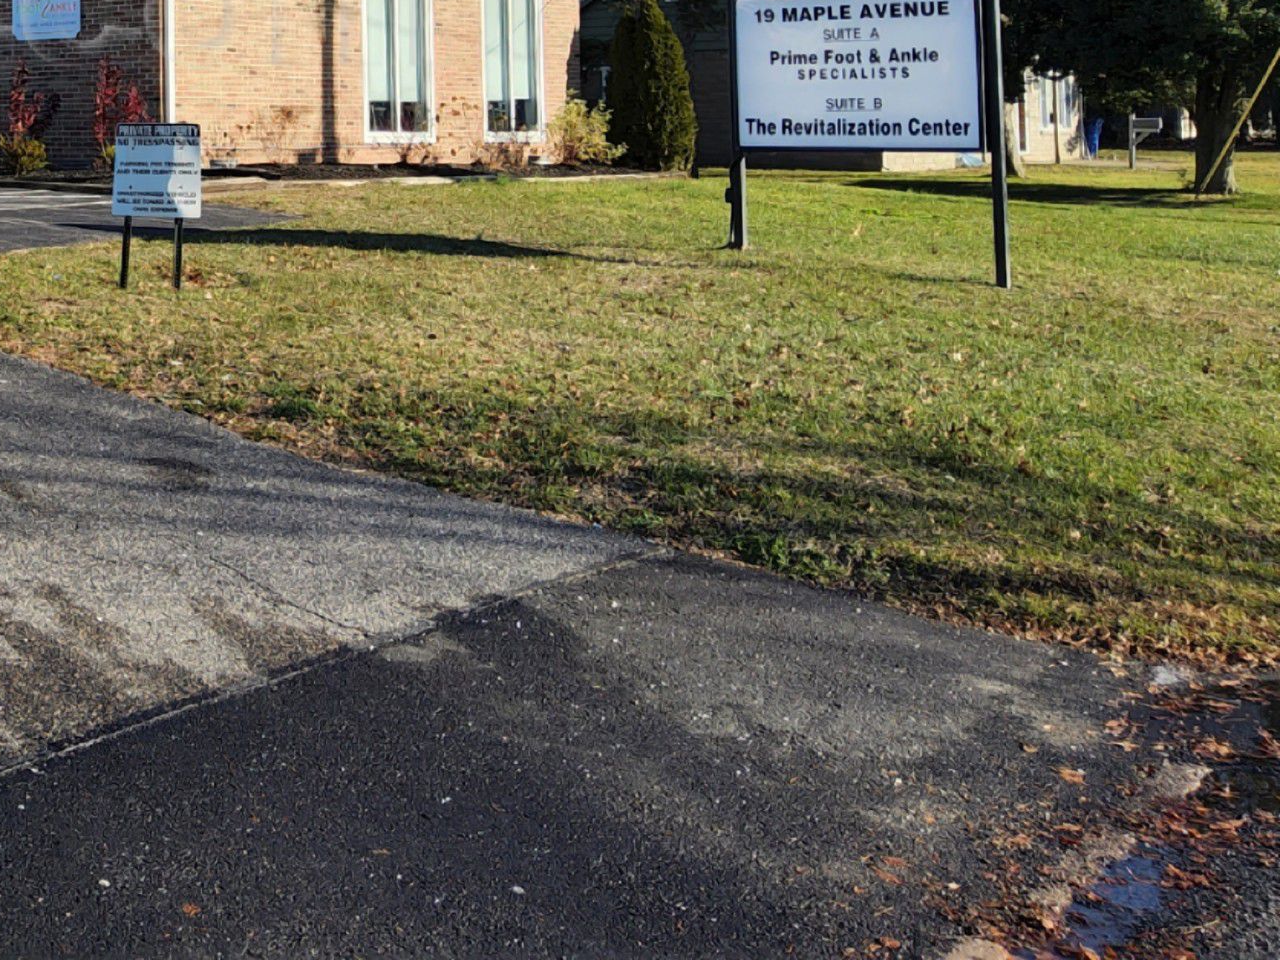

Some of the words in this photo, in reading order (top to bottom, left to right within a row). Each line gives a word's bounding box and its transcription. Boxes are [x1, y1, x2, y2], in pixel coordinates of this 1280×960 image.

[754, 8, 775, 23] 19
[782, 5, 851, 22] MAPLE
[860, 1, 950, 19] AVENUE
[823, 28, 861, 41] SUITE
[870, 28, 880, 40] A
[770, 50, 818, 65] Prime
[824, 49, 862, 64] Foot
[869, 49, 880, 63] &
[889, 47, 939, 63] Ankle
[797, 67, 910, 80] SPECIALISTS
[825, 98, 866, 111] SUITE
[873, 98, 882, 110] B
[745, 118, 777, 135] The
[782, 118, 902, 136] Revitalization
[908, 118, 970, 136] Center
